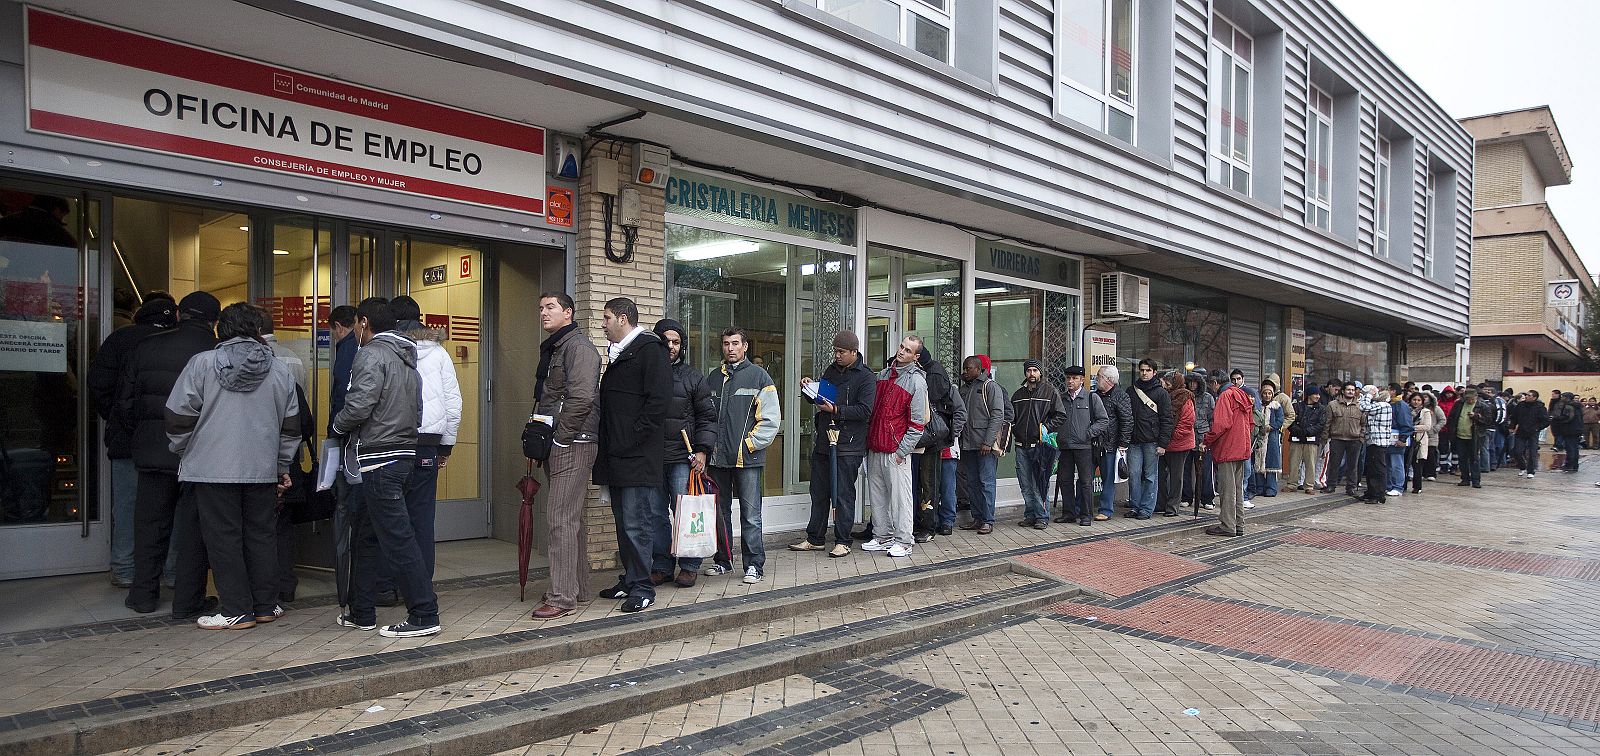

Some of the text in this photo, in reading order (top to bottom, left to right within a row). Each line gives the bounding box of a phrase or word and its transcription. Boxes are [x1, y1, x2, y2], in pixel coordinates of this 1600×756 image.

[296, 83, 389, 111] Comunidad de Madrid
[143, 88, 482, 176] OFICINA DE EMPLEO
[253, 156, 315, 173] CONSEJERÍA
[316, 167, 329, 175] DE
[331, 169, 368, 182] EMPLEO
[377, 177, 406, 189] MUJER
[665, 176, 855, 240] CRISTALERIA MENESES
[989, 247, 1040, 276] VIDRIERAS
[1092, 354, 1115, 366] pastillas
